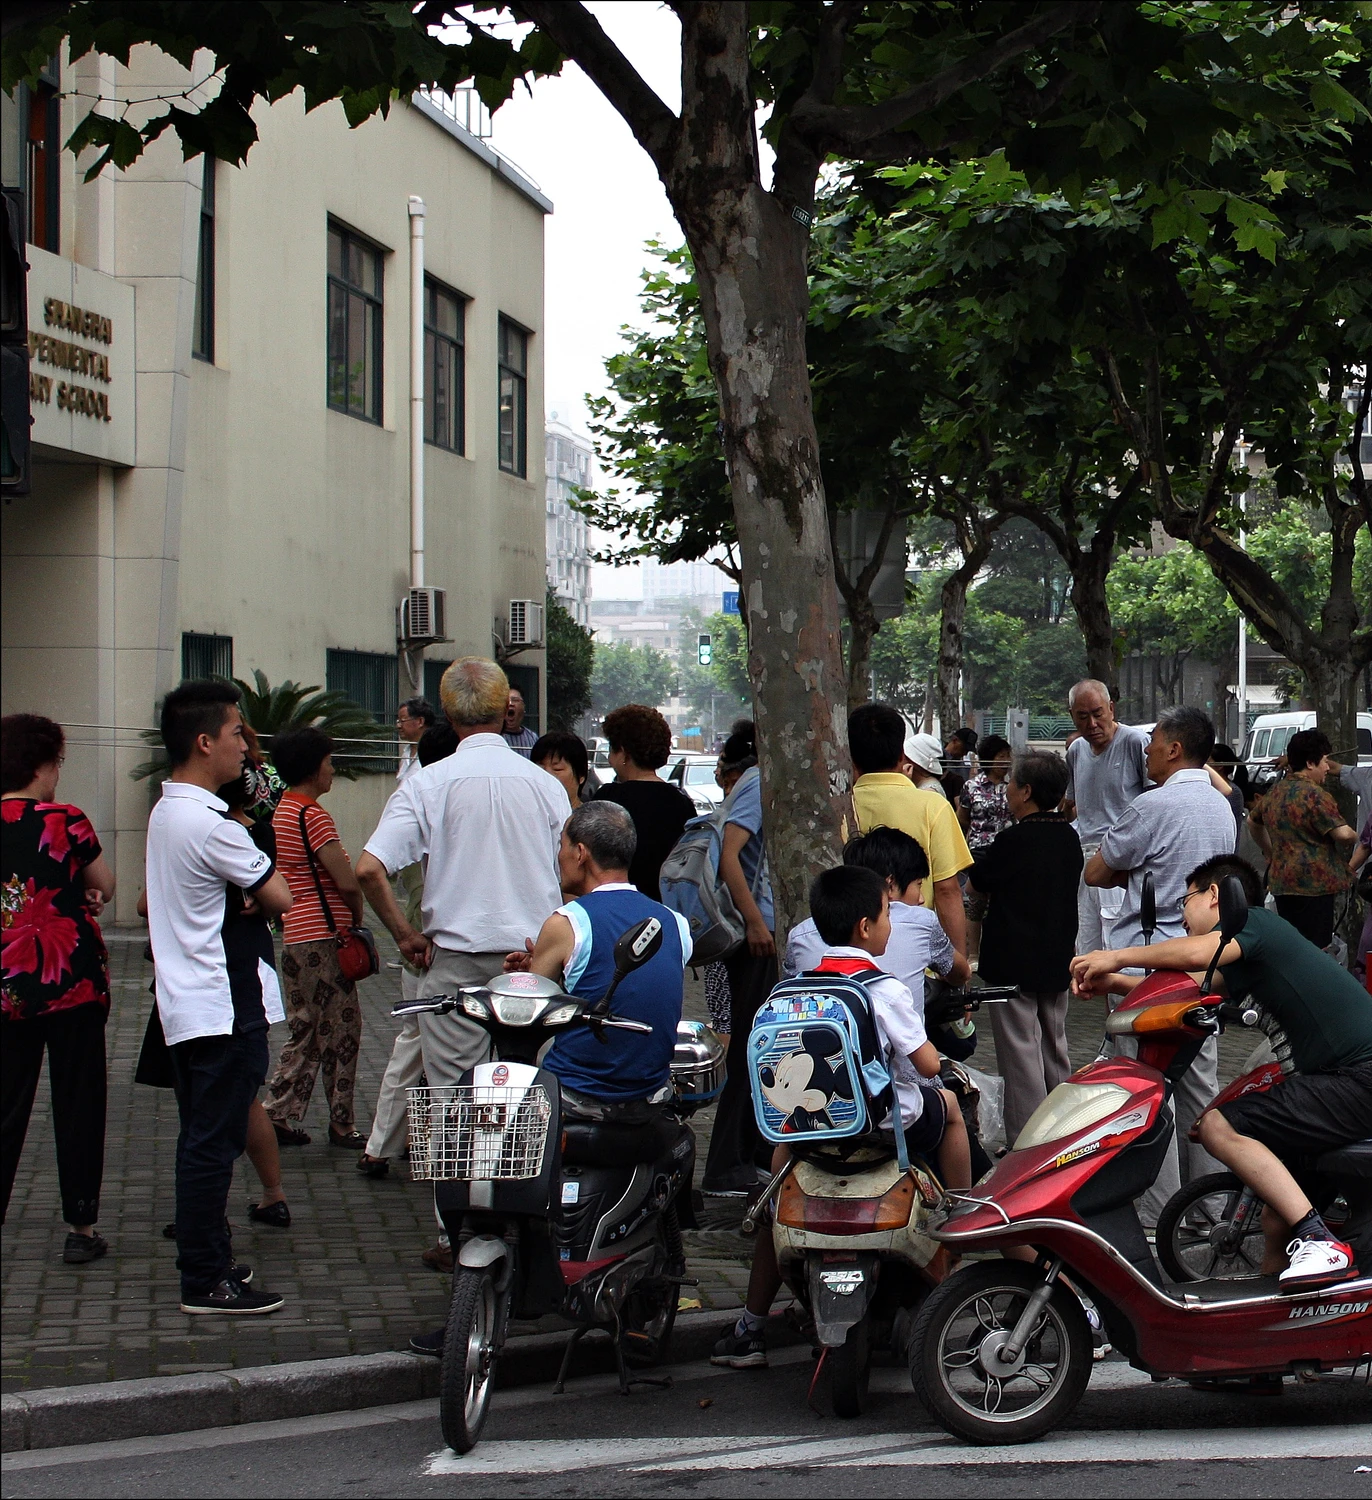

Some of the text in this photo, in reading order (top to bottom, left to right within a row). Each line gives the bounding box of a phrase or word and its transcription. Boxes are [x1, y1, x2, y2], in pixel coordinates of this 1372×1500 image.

[44, 296, 113, 345] SHANGHAI
[28, 330, 112, 384] PERIMENTAL
[30, 371, 112, 422] ARY SCHOOL
[1056, 1141, 1101, 1168] HANSOM
[1288, 1302, 1370, 1319] HANSOM
